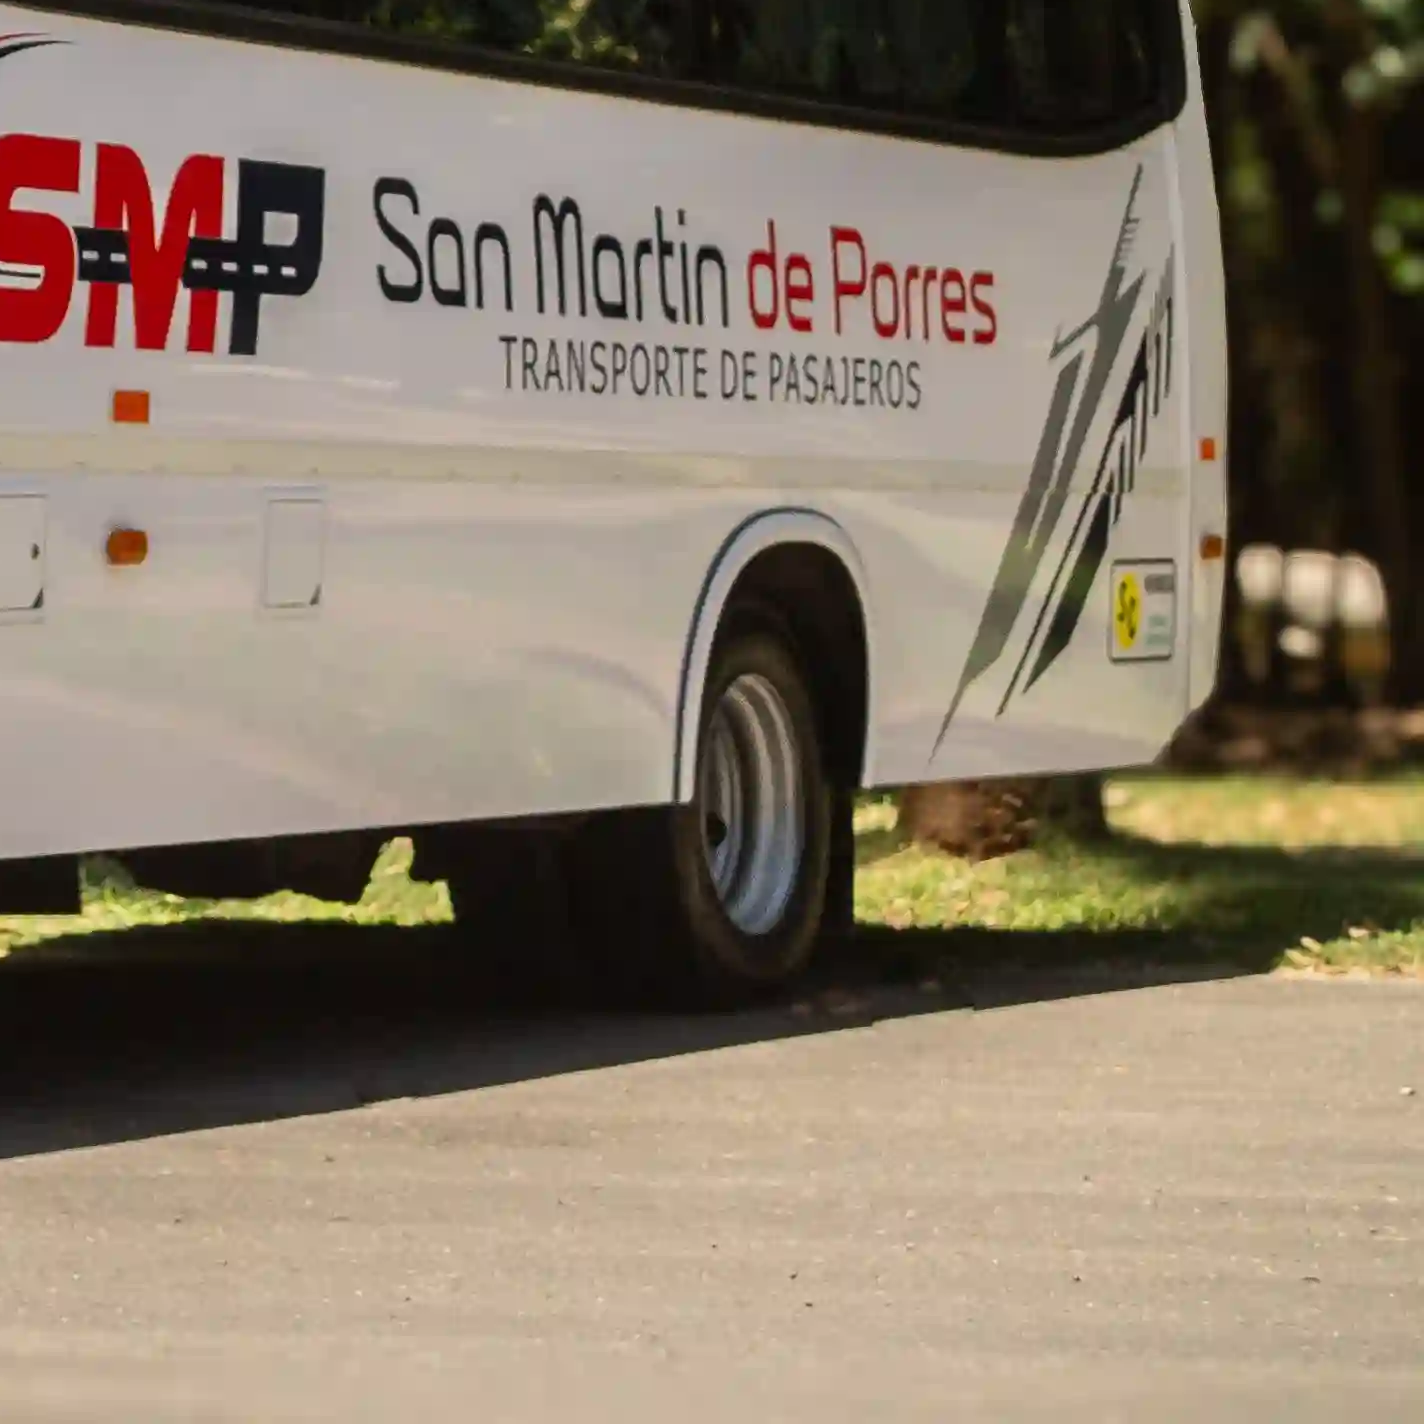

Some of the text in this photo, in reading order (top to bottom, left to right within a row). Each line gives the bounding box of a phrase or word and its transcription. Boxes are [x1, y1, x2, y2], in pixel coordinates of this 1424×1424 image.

[372, 176, 997, 345] San Martin de Porres
[498, 335, 922, 410] TRANSPORTE DE PASAJEROS
